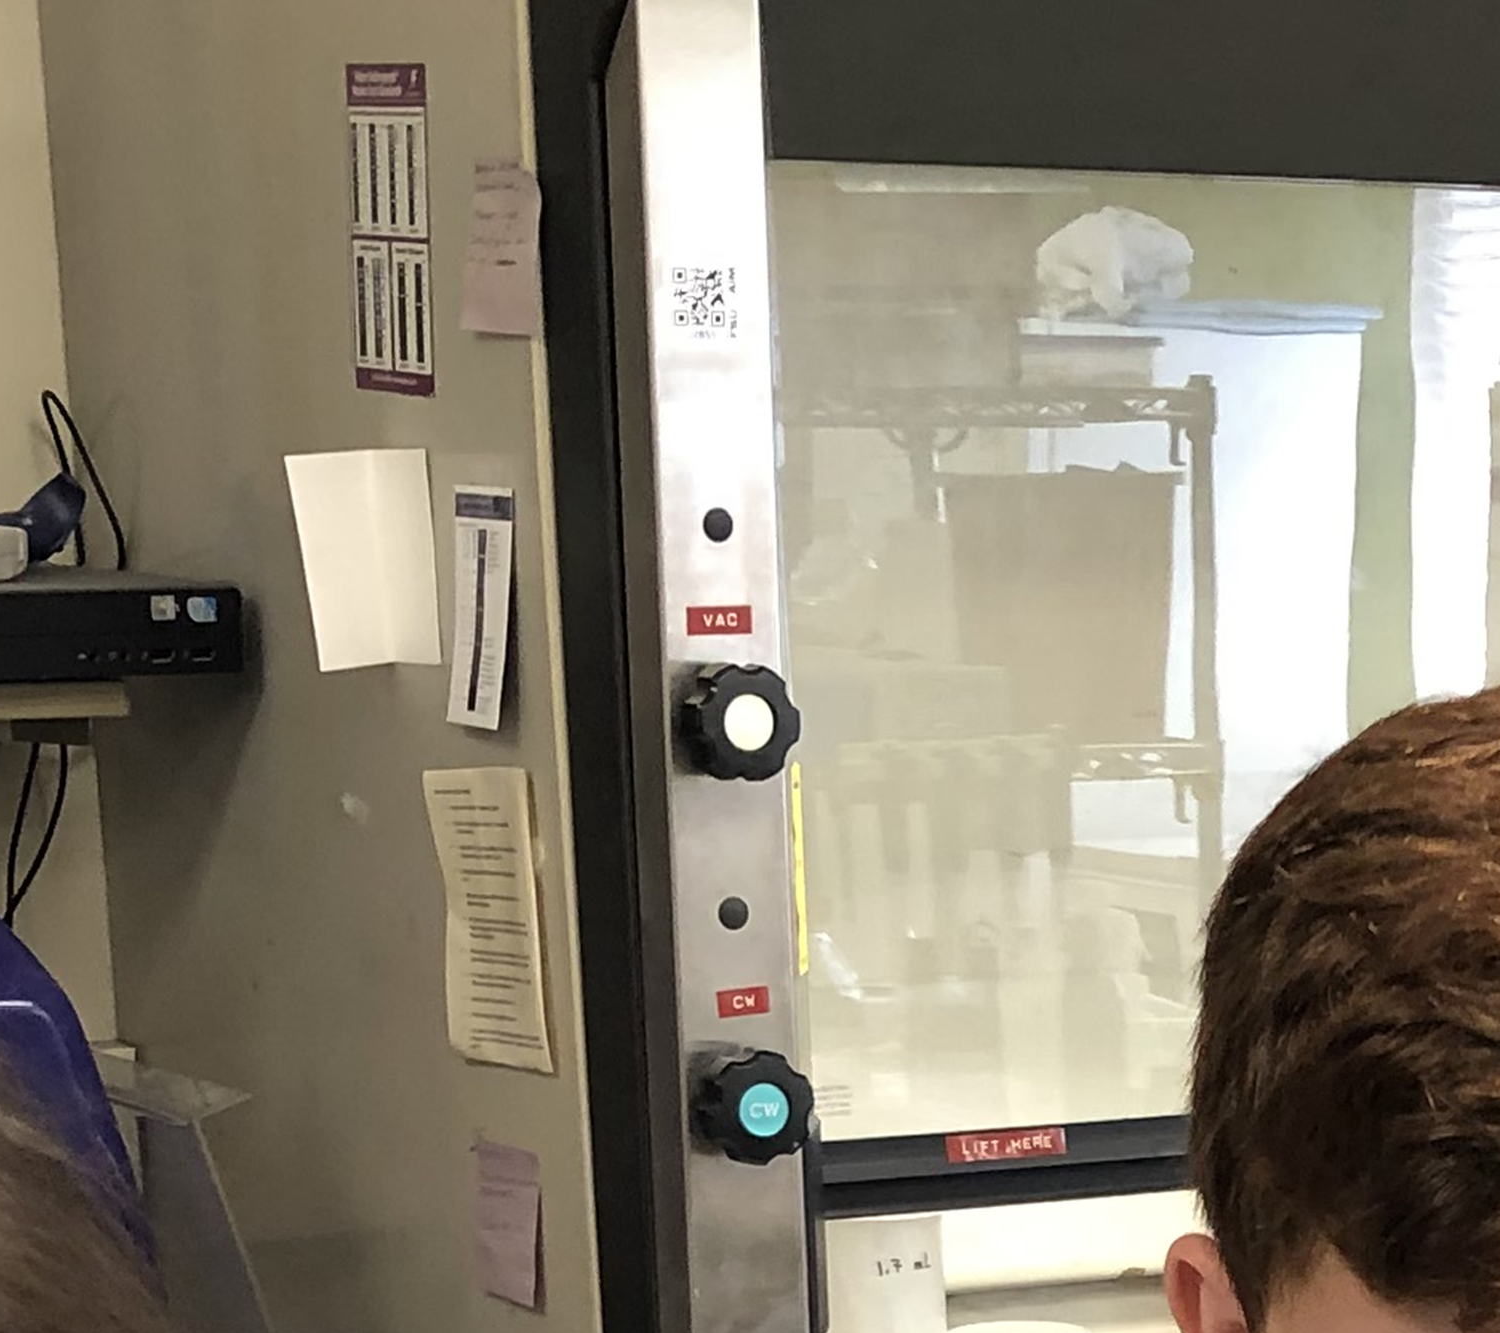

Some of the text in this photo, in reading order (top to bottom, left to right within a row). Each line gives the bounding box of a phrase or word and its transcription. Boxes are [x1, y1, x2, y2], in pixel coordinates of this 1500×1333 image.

[702, 612, 739, 628] VAC
[732, 994, 756, 1010] CW
[749, 1102, 781, 1118] CW
[1011, 1135, 1053, 1154] HERE
[876, 1258, 903, 1277] 1.7
